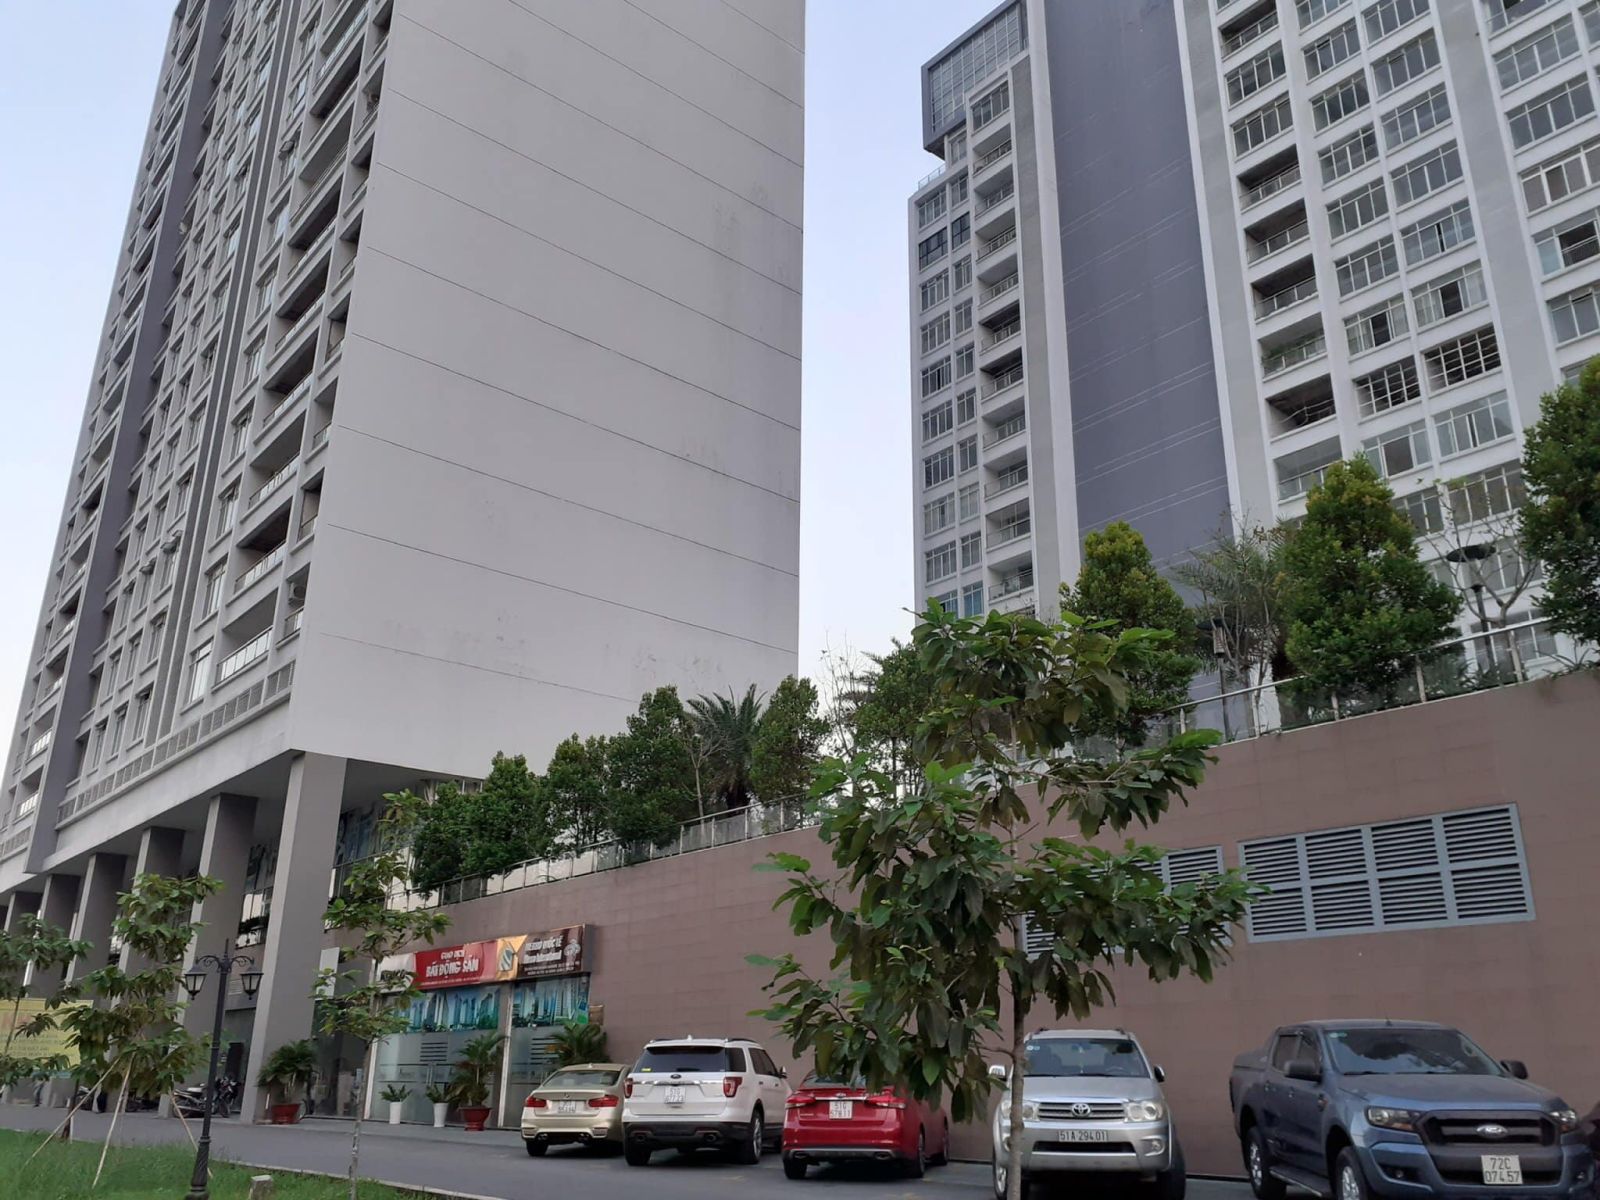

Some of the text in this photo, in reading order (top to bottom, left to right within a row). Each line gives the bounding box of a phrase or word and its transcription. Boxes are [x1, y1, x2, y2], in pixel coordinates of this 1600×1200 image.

[439, 960, 461, 978] ĐỘNG
[1059, 1130, 1076, 1141] 51A
[1489, 1157, 1512, 1170] 72C
